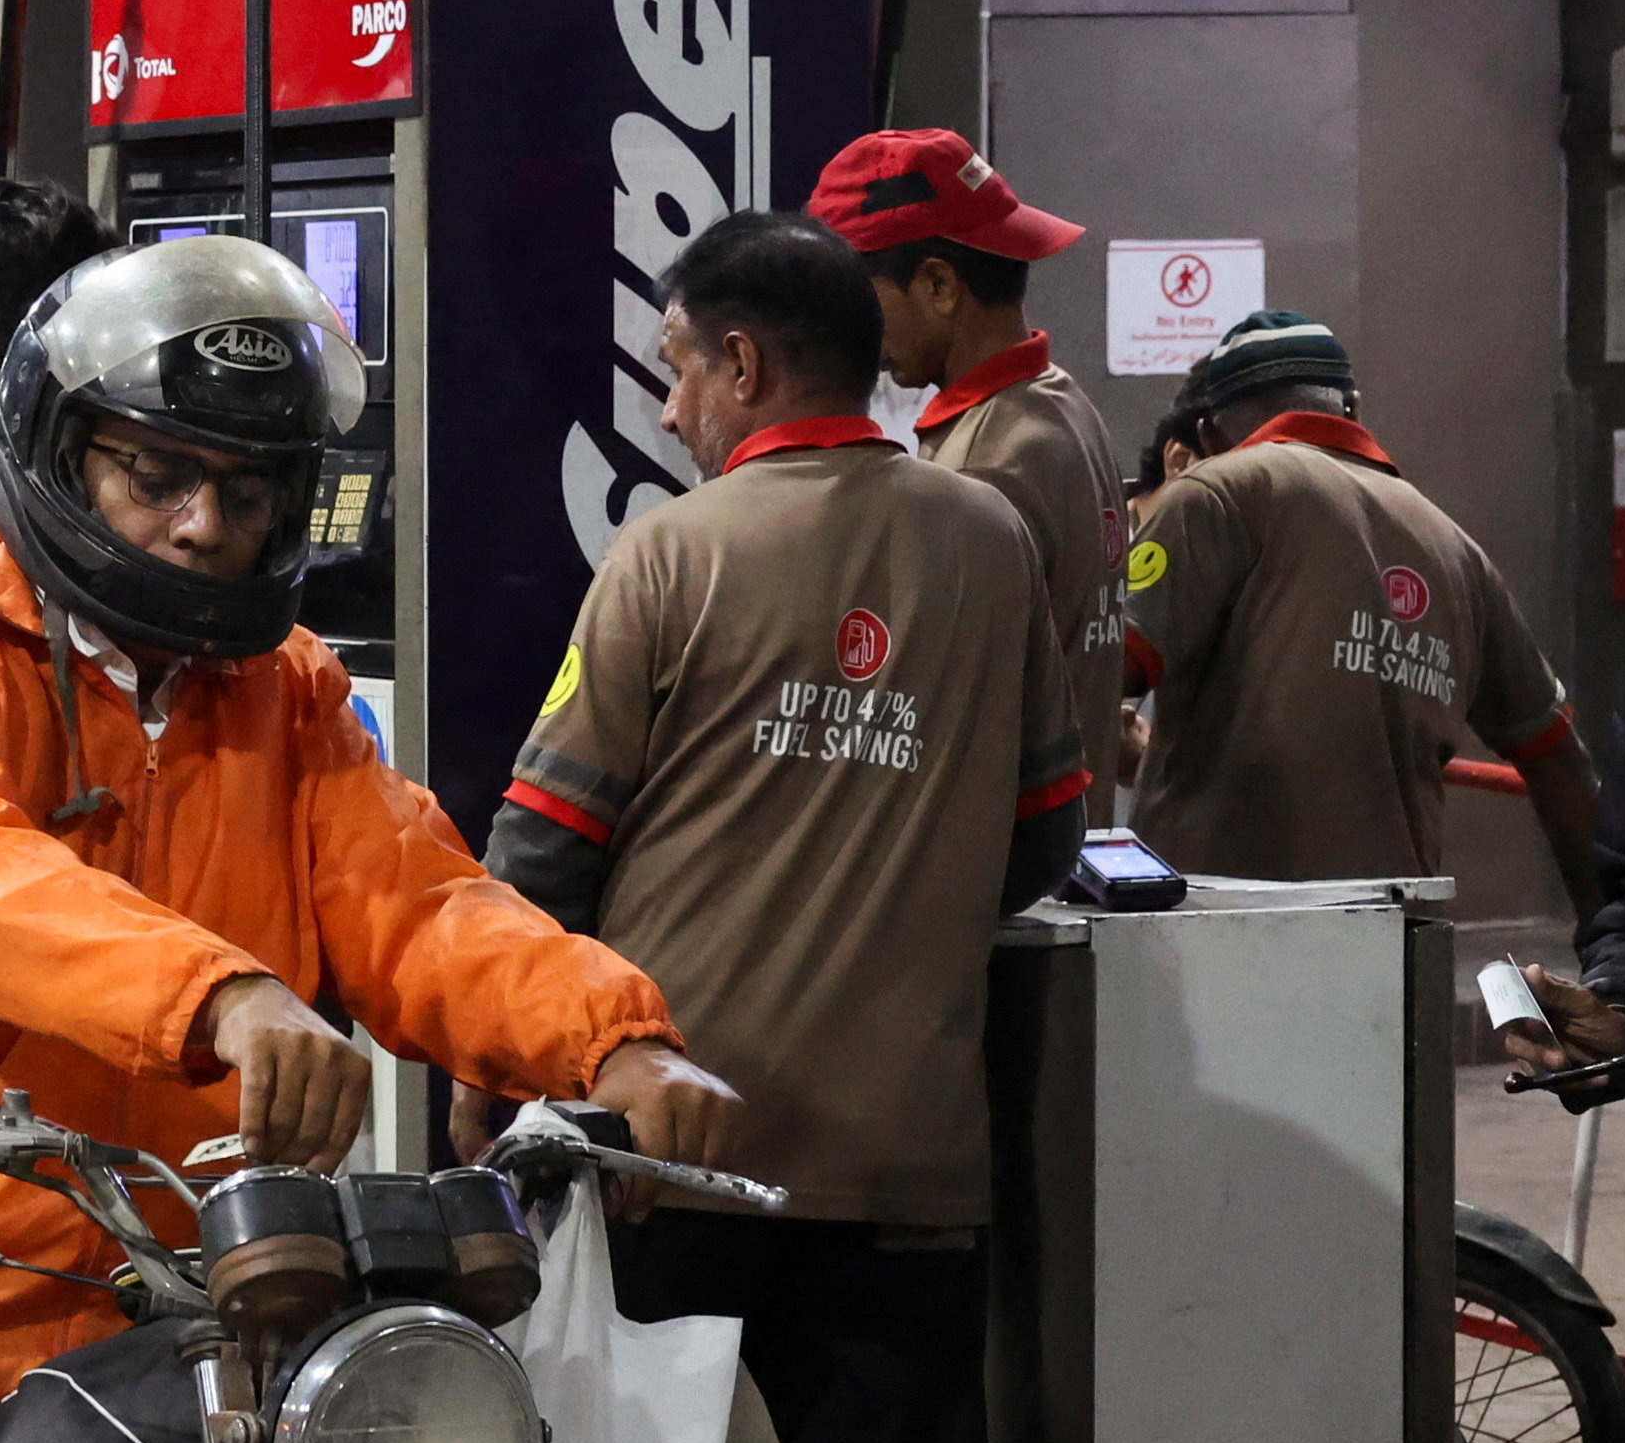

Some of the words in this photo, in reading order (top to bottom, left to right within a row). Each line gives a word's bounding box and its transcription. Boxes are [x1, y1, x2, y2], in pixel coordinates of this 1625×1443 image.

[351, 0, 407, 36] PARCO
[205, 327, 286, 362] Asia
[780, 681, 818, 718] UP
[821, 685, 851, 723] TO
[856, 688, 917, 731] 4.7%
[752, 719, 811, 757] FUEL
[820, 724, 923, 773] SAVINGS
